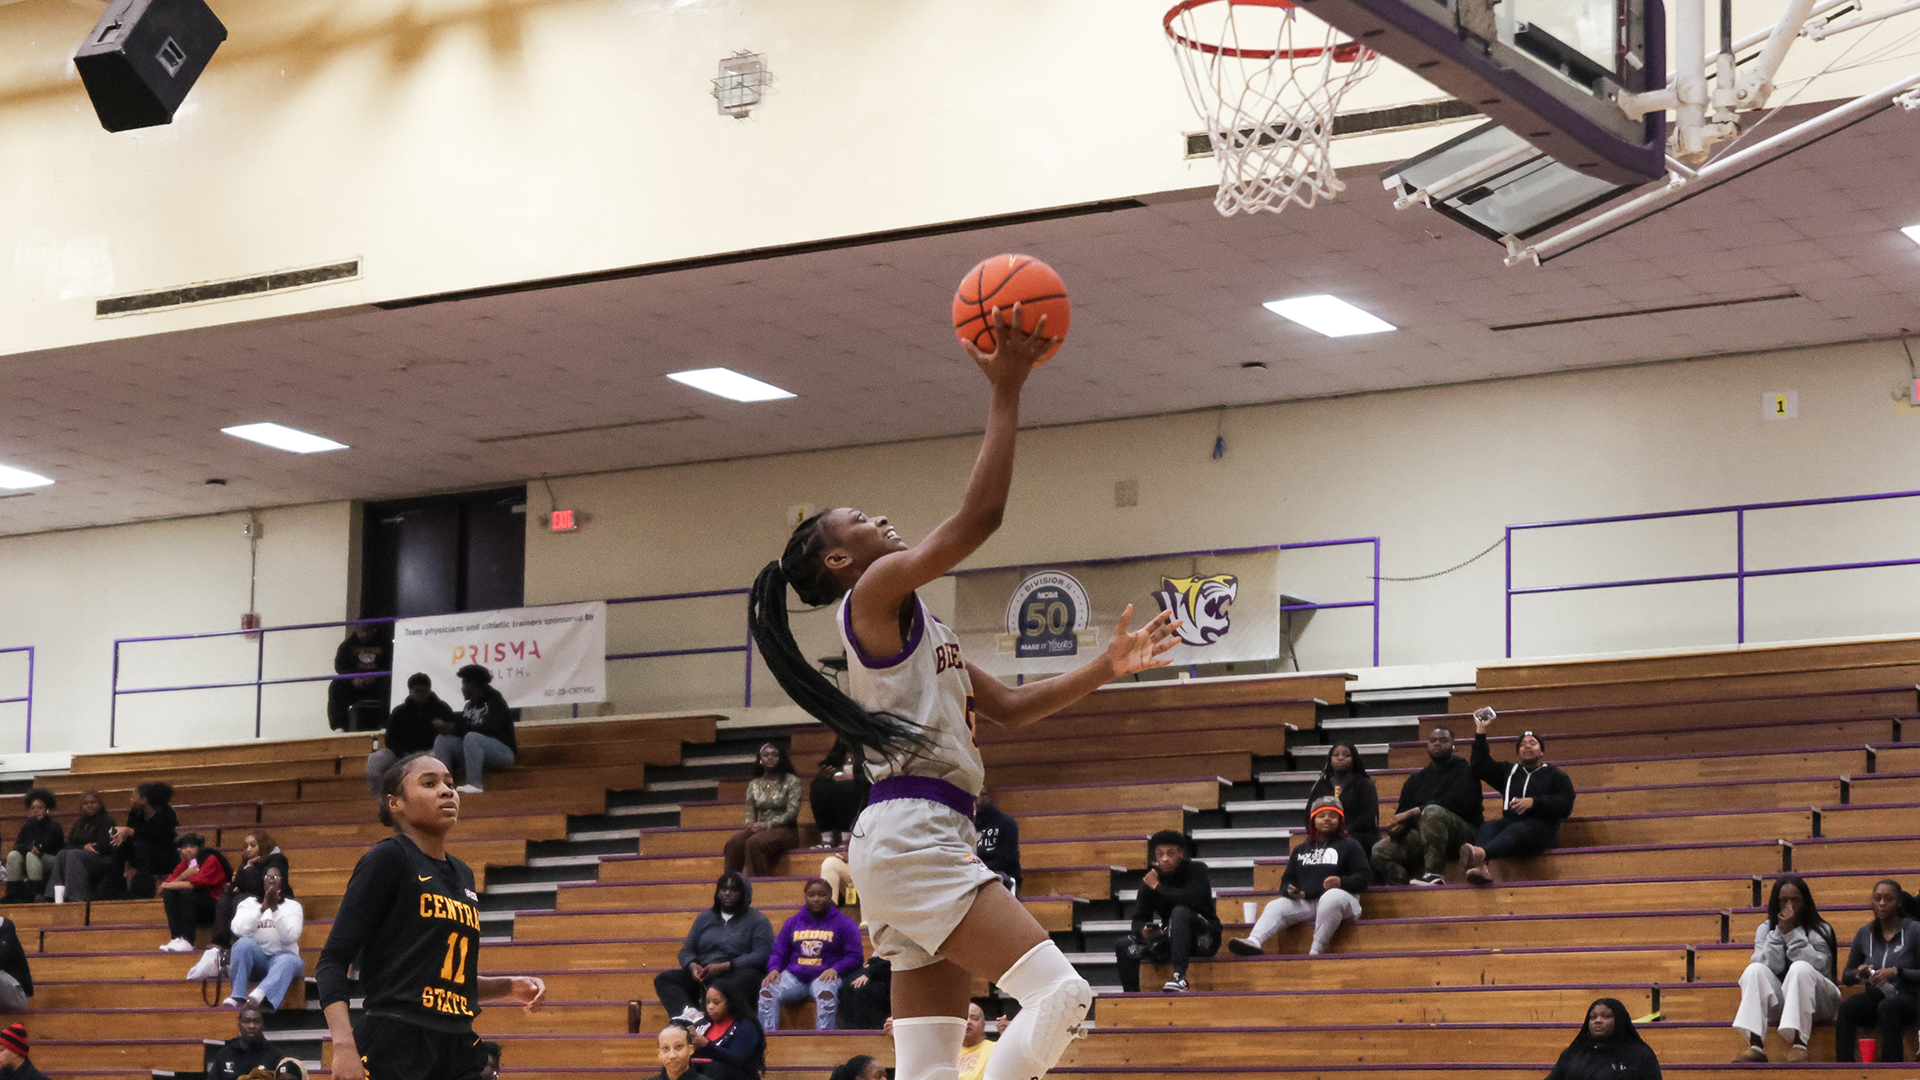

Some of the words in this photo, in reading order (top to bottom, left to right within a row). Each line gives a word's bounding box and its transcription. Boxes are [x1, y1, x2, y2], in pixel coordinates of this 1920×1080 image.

[1777, 400, 1784, 413] 1
[552, 510, 573, 529] EXIT
[1024, 577, 1064, 592] DIVISION
[405, 628, 423, 636] Team
[425, 625, 463, 636] physicians
[466, 623, 480, 631] and
[482, 621, 511, 630] athletic
[512, 619, 542, 628] trainers
[544, 614, 583, 625] sponsored
[585, 613, 594, 622] by
[1026, 601, 1068, 637] 50
[452, 640, 541, 665] PRISMA
[1048, 638, 1074, 652] YOURS
[420, 893, 481, 931] CENTRA
[440, 932, 469, 984] 11
[422, 986, 474, 1016] STATE
